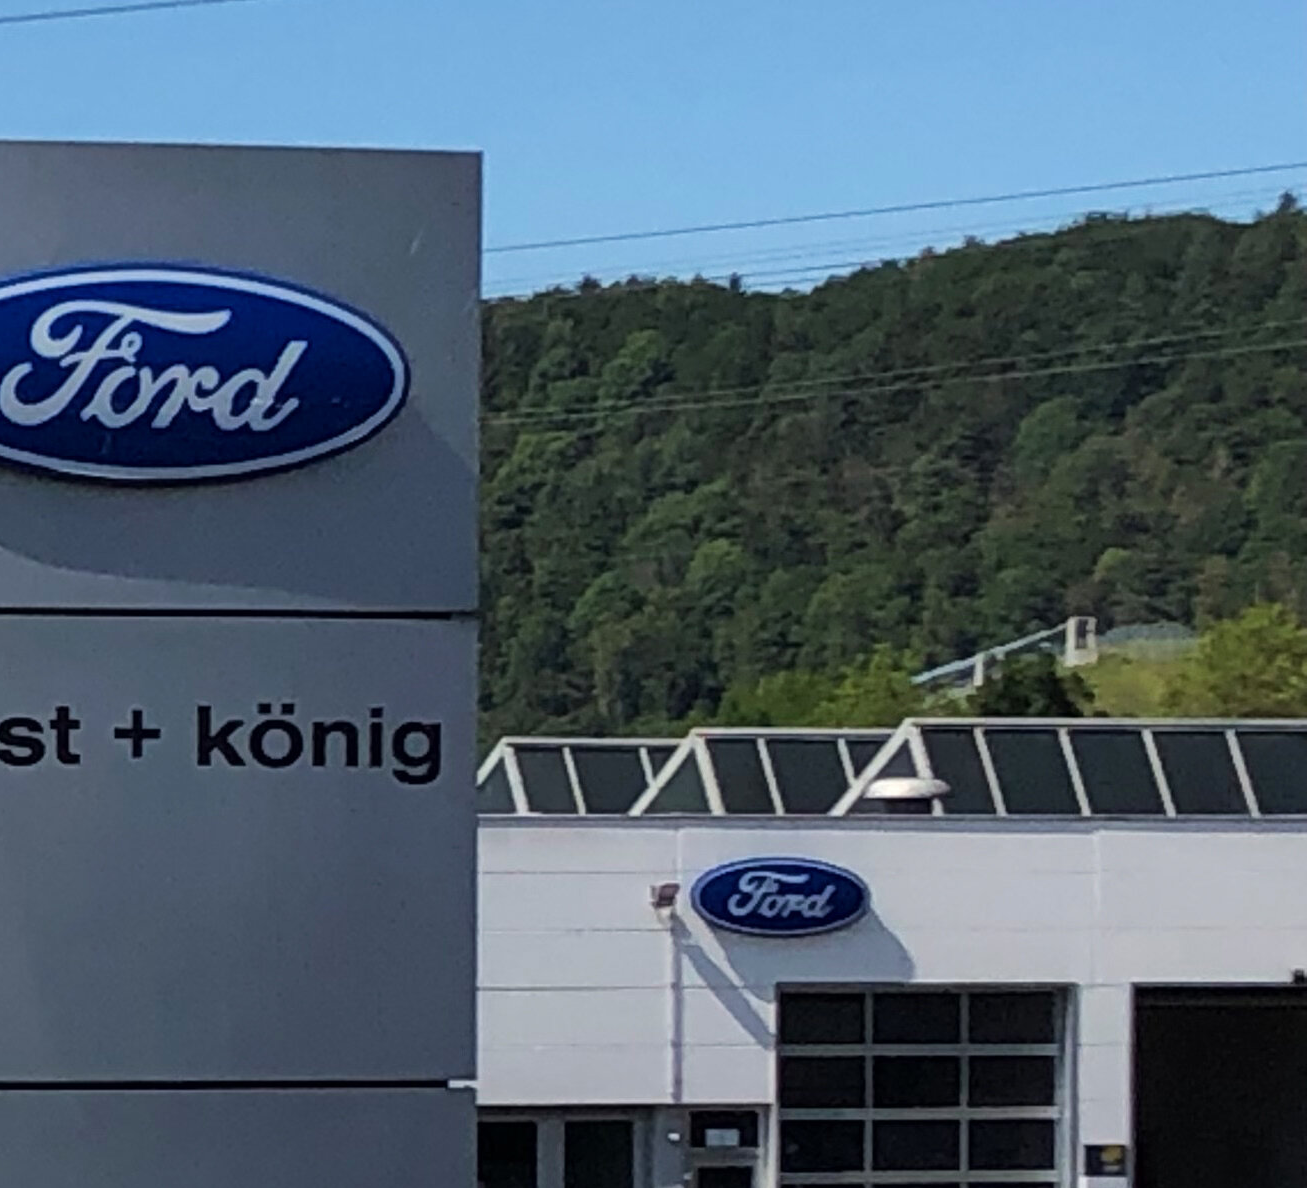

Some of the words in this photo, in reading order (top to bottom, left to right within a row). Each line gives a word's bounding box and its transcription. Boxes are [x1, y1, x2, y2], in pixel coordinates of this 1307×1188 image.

[112, 708, 162, 760] +
[196, 702, 442, 786] könig
[726, 871, 836, 919] Ford
